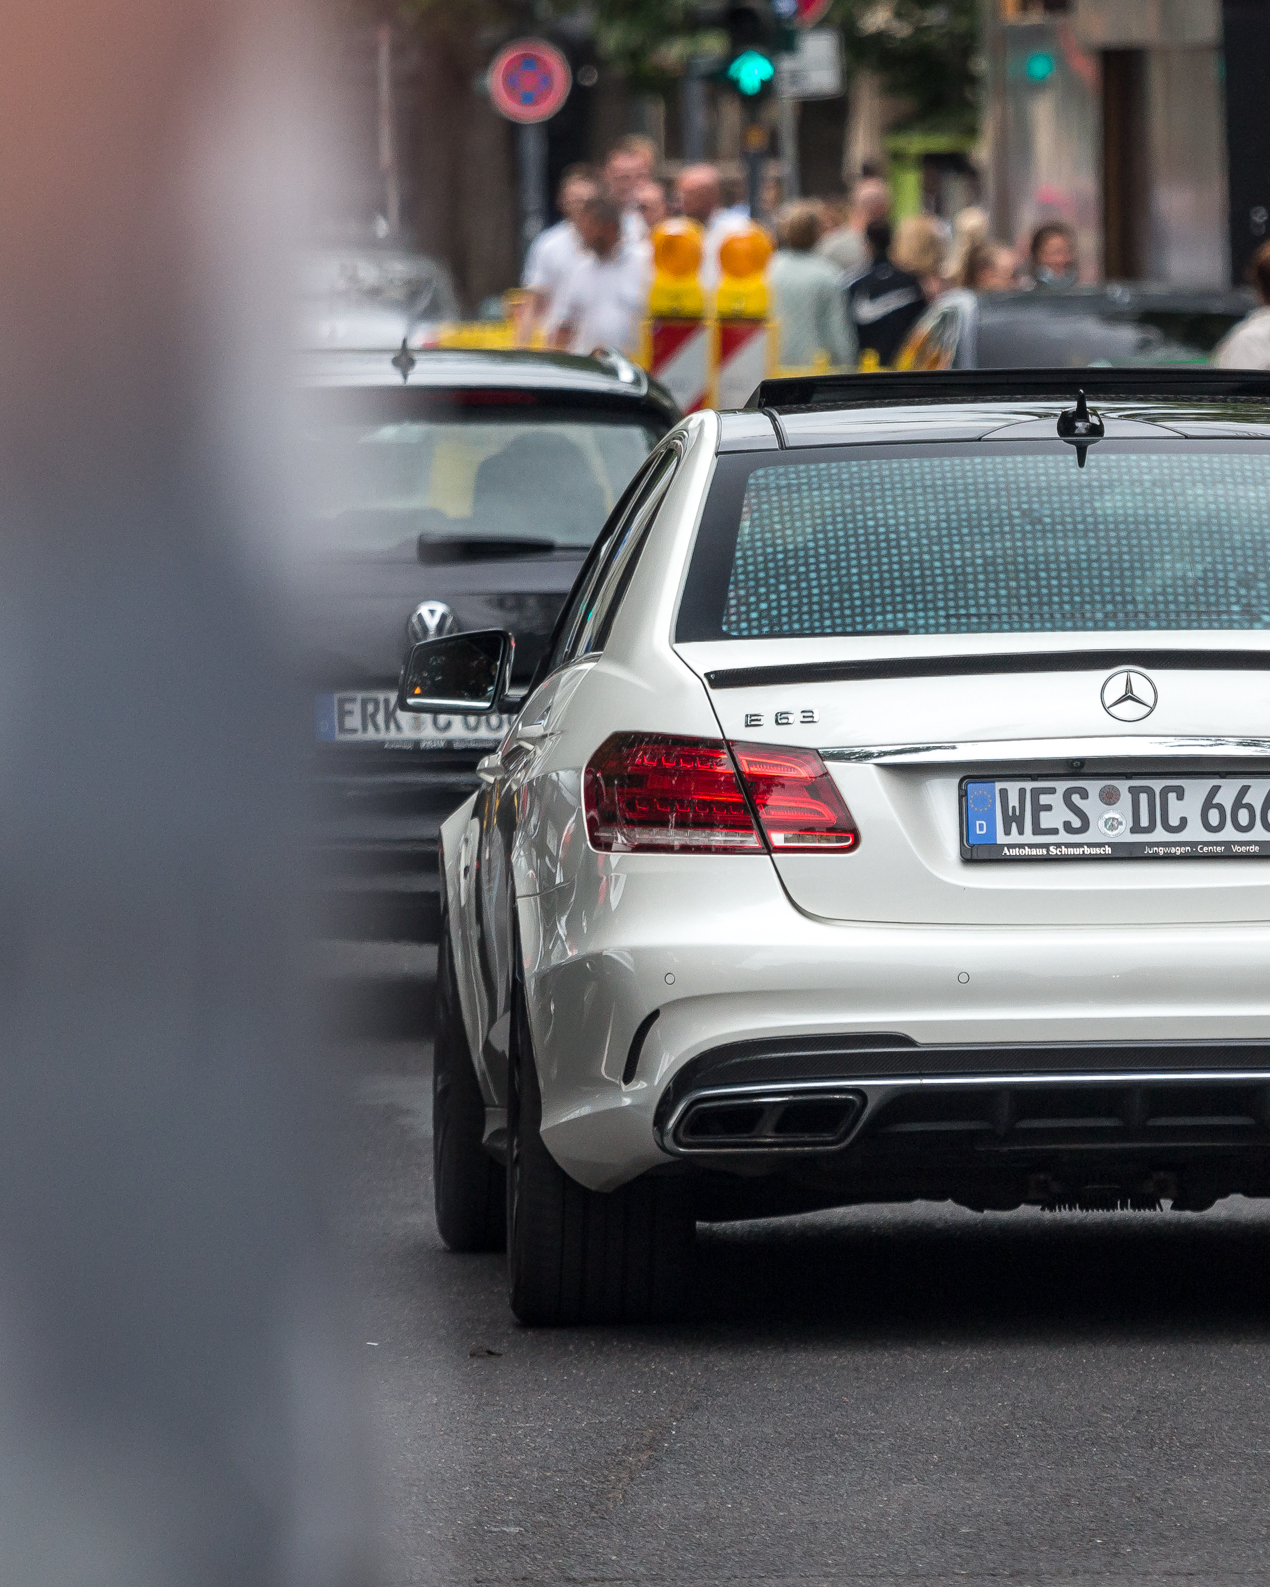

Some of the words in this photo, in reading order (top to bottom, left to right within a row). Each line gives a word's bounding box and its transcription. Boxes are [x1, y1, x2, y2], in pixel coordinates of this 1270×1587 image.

[337, 696, 403, 734] ERK
[745, 713, 764, 728] E
[775, 709, 819, 725] 63
[999, 786, 1090, 836] WES
[1128, 785, 1188, 835] DC
[975, 820, 987, 835] D
[1002, 846, 1047, 856] Autohaus
[1049, 845, 1112, 856] Schnurbusch
[1144, 845, 1191, 856] Jungwagen
[1197, 844, 1225, 853] Center
[1231, 844, 1260, 853] Voerde
